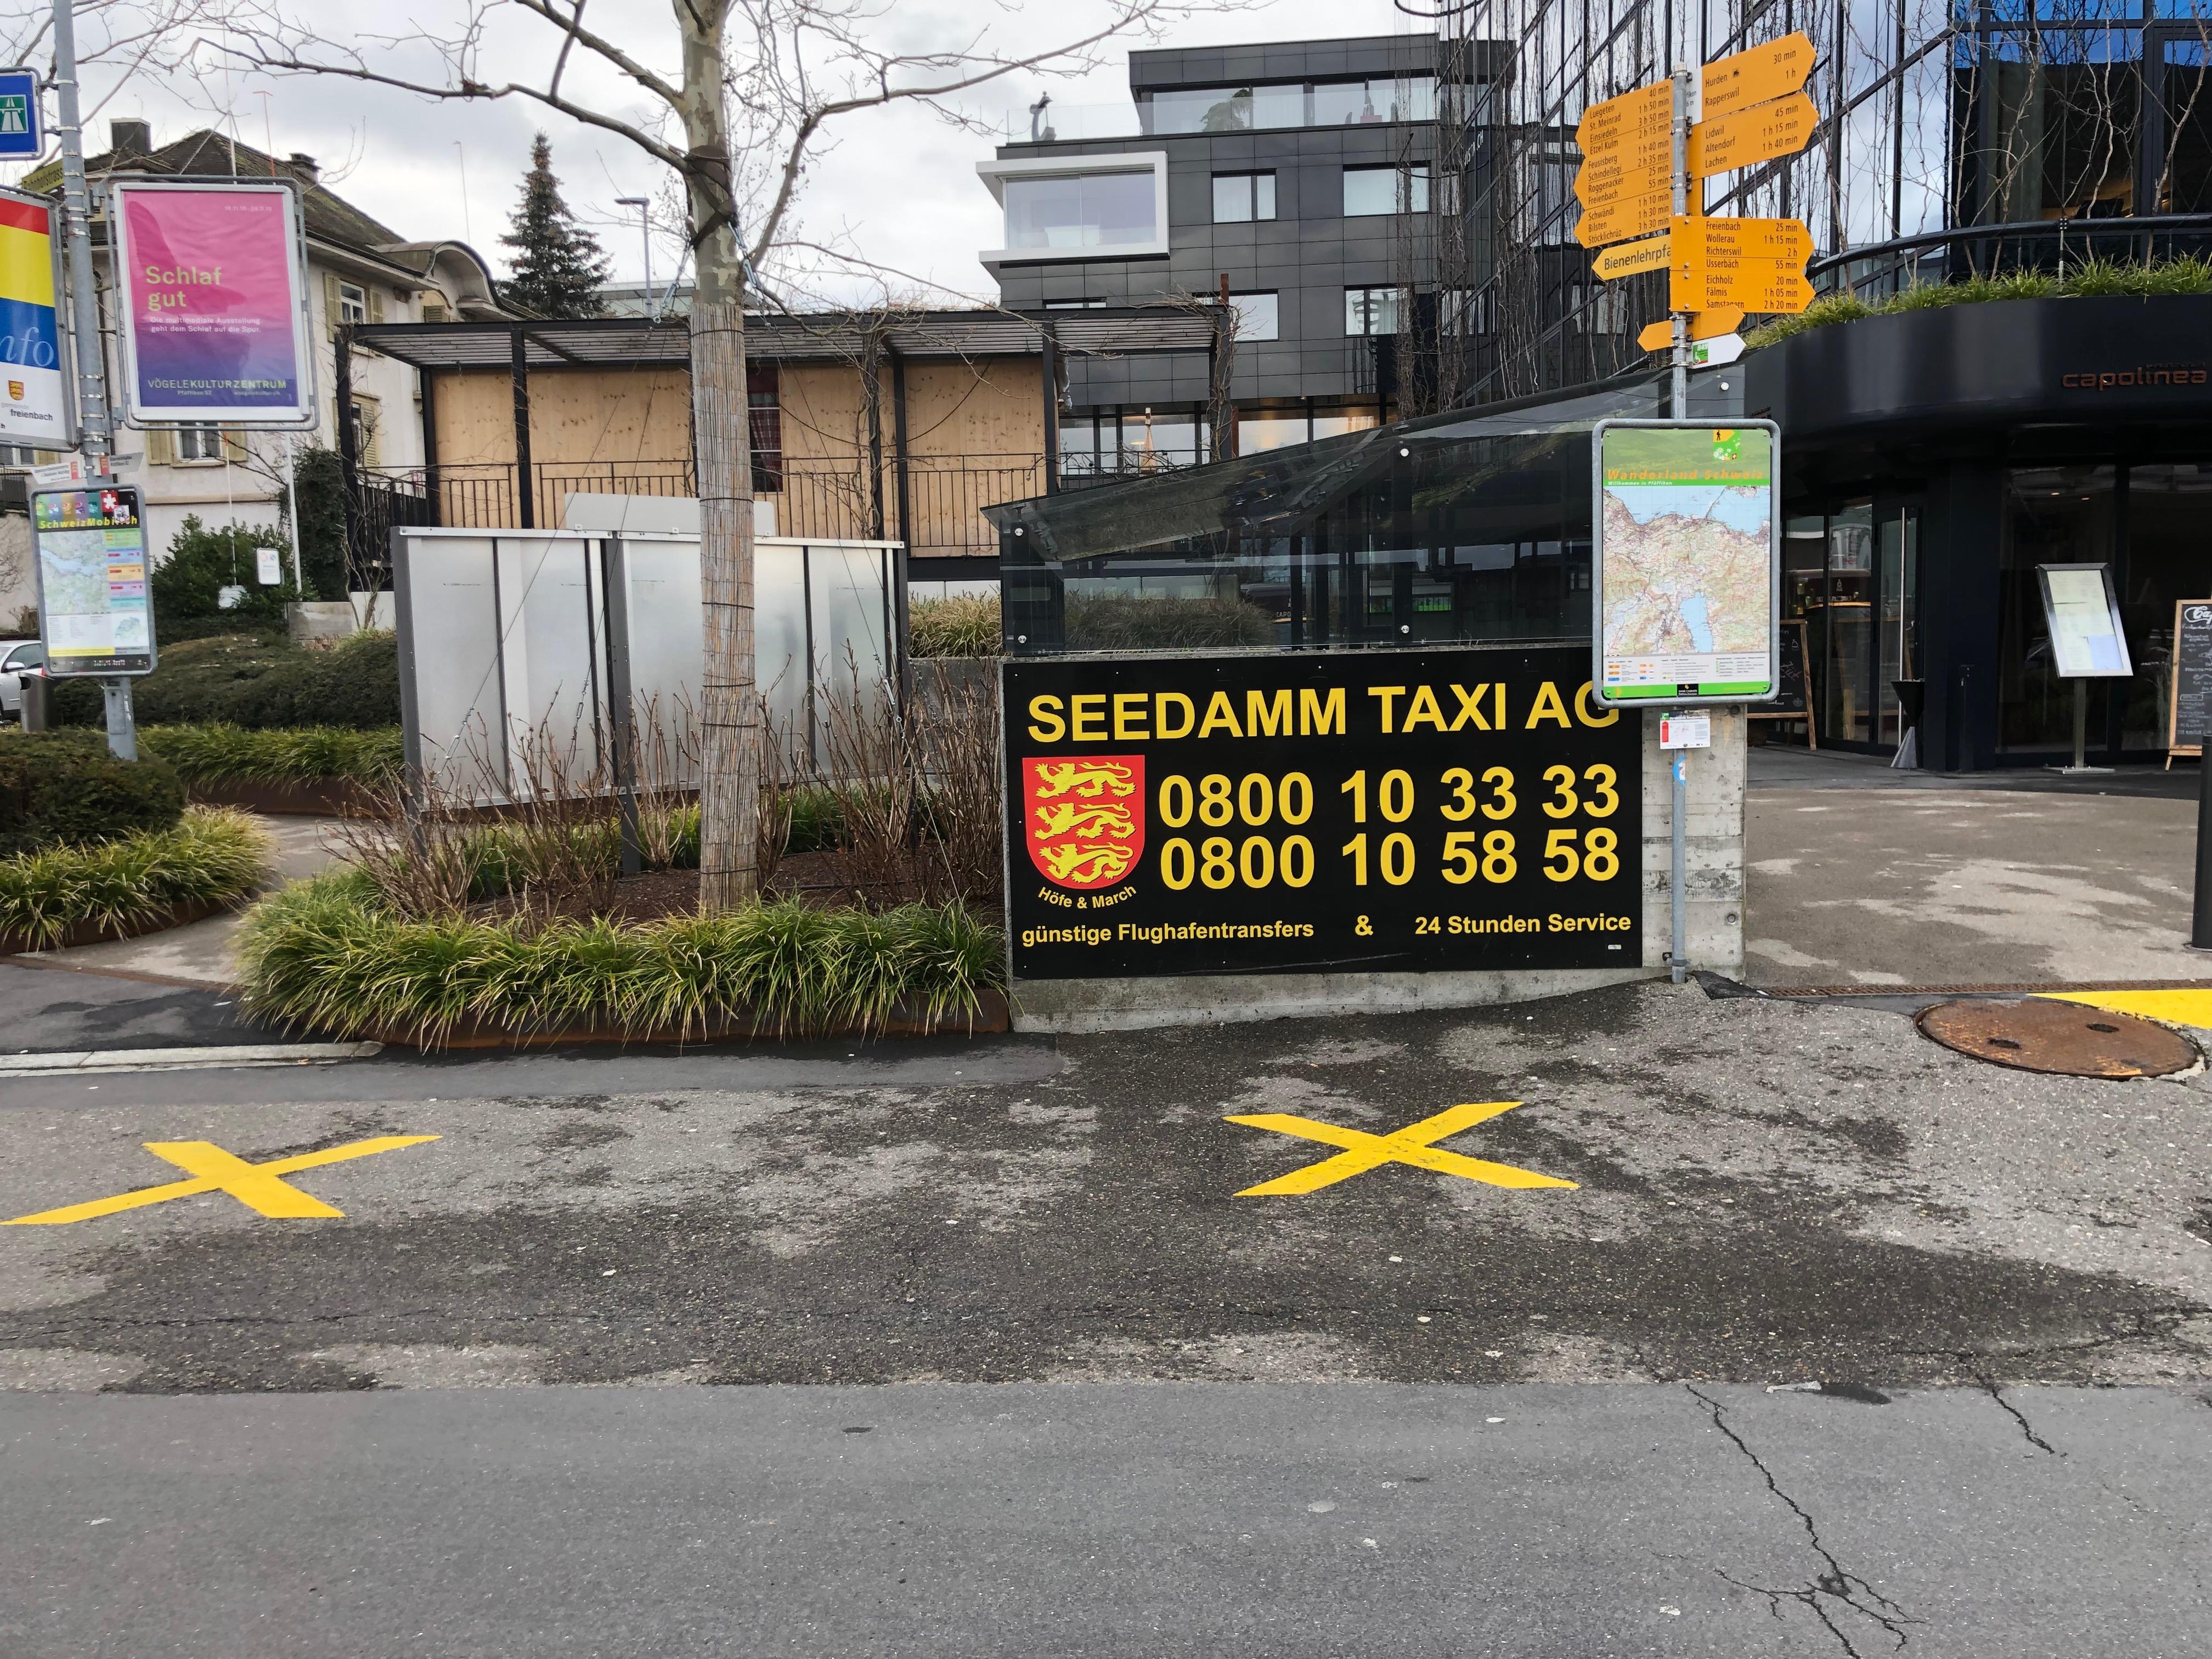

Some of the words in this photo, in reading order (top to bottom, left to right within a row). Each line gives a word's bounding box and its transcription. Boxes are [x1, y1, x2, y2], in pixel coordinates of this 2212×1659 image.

[1705, 73, 1728, 88] Hurden
[1774, 53, 1781, 64] 30
[1784, 49, 1796, 61] min
[1705, 87, 1740, 107] Rapperswil
[1791, 68, 1796, 77] h
[1590, 105, 1615, 119] Luegeten
[1649, 88, 1656, 97] 40
[1658, 85, 1669, 95] min
[1599, 112, 1621, 127] Meinrad
[1644, 104, 1647, 112] h
[1649, 101, 1656, 110] 50
[1658, 98, 1669, 108] min
[1590, 127, 1617, 143] Einsiedeln
[1639, 118, 1642, 127] 3
[1644, 116, 1647, 125] h
[1649, 114, 1656, 123] 50
[1658, 110, 1669, 120] min
[1706, 125, 1724, 139] Lidwil
[1775, 108, 1784, 117] 45
[1786, 104, 1798, 115] min
[1590, 143, 1602, 155] Etzel
[1605, 139, 1618, 149] Kulm
[1644, 128, 1647, 137] h
[1650, 126, 1656, 136] 15
[1658, 123, 1669, 133] min
[1705, 136, 1736, 154] Altendorf
[1769, 126, 1773, 135] h
[1775, 123, 1783, 133] 15
[1786, 120, 1798, 131] min
[1589, 155, 1617, 170] Feusisberg
[1643, 145, 1647, 153] h
[1649, 142, 1656, 151] 40
[1658, 139, 1669, 149] min
[1705, 155, 1727, 168] Lachen
[1768, 140, 1773, 150] h
[1775, 138, 1783, 148] 40
[1785, 135, 1798, 146] min
[1589, 164, 1622, 181] Schindellegi
[1643, 157, 1647, 166] h
[1649, 155, 1656, 164] 35
[1658, 152, 1669, 162] min
[1589, 177, 1624, 194] Roggenacker
[1649, 167, 1656, 176] 25
[1658, 164, 1669, 174] min
[1589, 189, 1618, 205] Freienbach
[1649, 179, 1656, 188] 55
[1658, 177, 1669, 186] min
[1589, 206, 1615, 221] Schwändi
[1643, 198, 1647, 206] h
[1649, 195, 1656, 204] 10
[1658, 193, 1669, 202] min
[1589, 222, 1607, 233] Bilsten
[1643, 210, 1647, 218] h
[1649, 207, 1656, 217] 30
[1658, 205, 1669, 215] min
[1638, 222, 1641, 232] 3
[1643, 222, 1647, 230] h
[1649, 219, 1656, 229] 30
[1658, 217, 1669, 227] min
[1706, 222, 1741, 230] Freienbach
[1776, 223, 1784, 232] 25
[1786, 223, 1797, 232] min
[1706, 234, 1735, 243] Wollerau
[1770, 235, 1774, 244] h
[1776, 235, 1784, 244] 15
[1786, 235, 1797, 245] min
[1706, 246, 1742, 256] Richterswil
[1793, 248, 1797, 257] h
[1605, 244, 1671, 270] Bienenlehrpfa
[1706, 259, 1739, 268] Usserbäch
[1776, 260, 1784, 269] 55
[1786, 260, 1797, 269] min
[146, 266, 222, 285] Schlaf
[1706, 275, 1733, 284] Eichholz
[1776, 276, 1784, 285] 20
[1786, 276, 1798, 285] min
[148, 291, 187, 312] gut
[1706, 287, 1727, 296] Fälmis
[1770, 288, 1774, 297] h
[1776, 288, 1784, 297] 05
[1786, 288, 1798, 297] min
[1770, 300, 1774, 309] h
[1776, 301, 1784, 309] 20
[1786, 300, 1798, 309] min
[0, 326, 54, 366] nfo
[2062, 367, 2207, 391] capolinea
[10, 408, 53, 421] freienbach
[1607, 469, 1698, 479] Wanderland
[1705, 470, 1763, 480] Schweiz
[1028, 688, 1346, 743] SEEDAMM
[1368, 683, 1506, 733] TAXI
[1525, 680, 1619, 729] AG
[1159, 772, 1313, 828] 0800
[1342, 769, 1415, 823] 10
[1440, 766, 1517, 821] 33
[1542, 764, 1620, 818] 33
[1161, 835, 1314, 890] 0800
[1342, 833, 1415, 886] 10
[1442, 830, 1517, 884] 58
[1543, 827, 1620, 882] 58
[1038, 887, 1073, 909] Höfe
[1076, 898, 1087, 909] &
[1092, 884, 1137, 909] March
[1022, 926, 1112, 947] günstige
[1119, 921, 1314, 944] Flughafentransfers
[1355, 915, 1373, 936] &
[1415, 916, 1441, 934] 24
[1448, 915, 1541, 934] Stunden
[1548, 913, 1632, 932] Service
